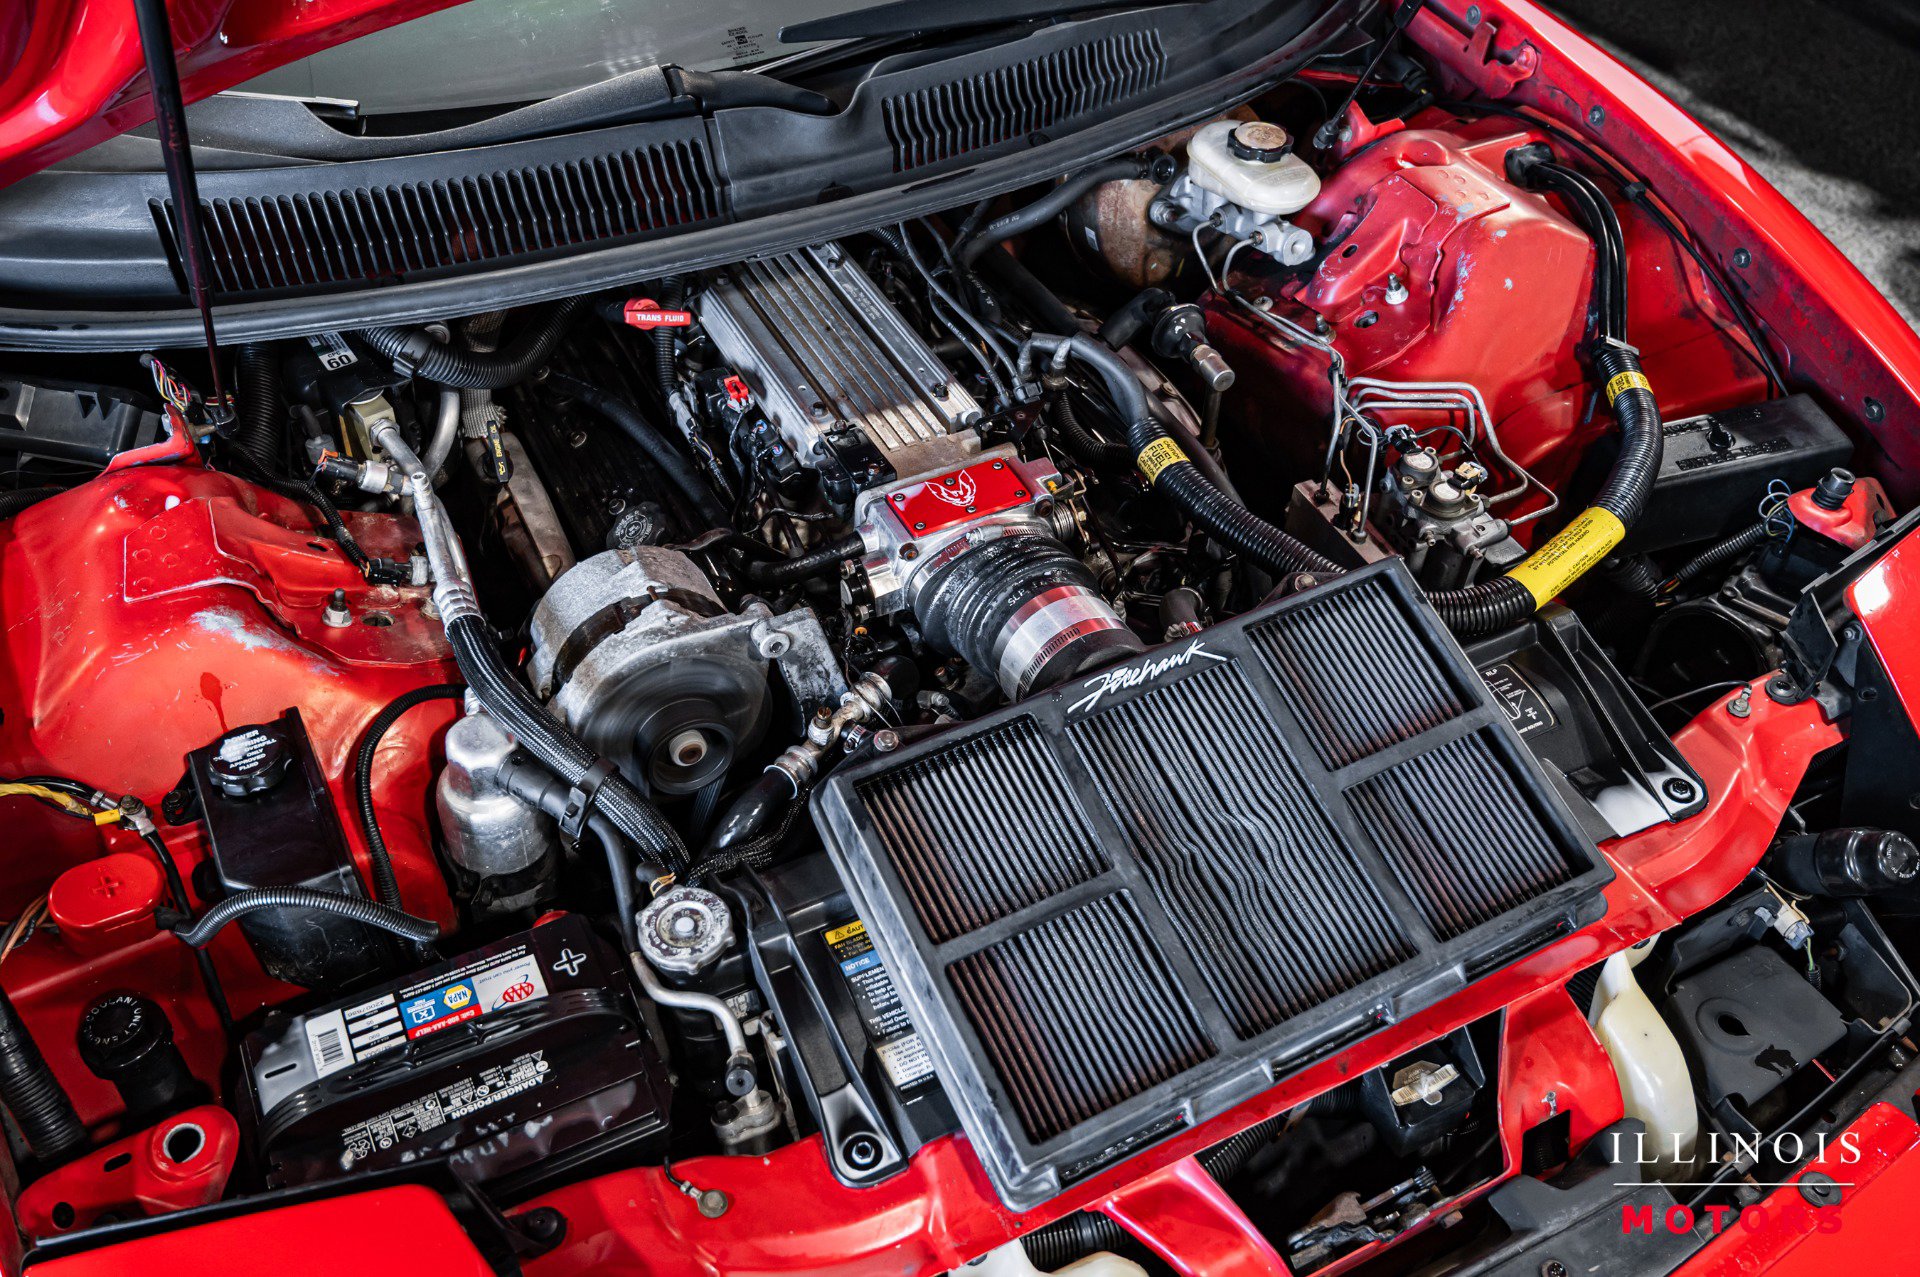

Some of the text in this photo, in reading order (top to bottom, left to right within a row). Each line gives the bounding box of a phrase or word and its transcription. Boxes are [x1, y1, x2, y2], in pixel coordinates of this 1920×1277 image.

[636, 313, 685, 322] TRANS FLUID
[327, 354, 352, 369] 60
[1148, 445, 1166, 466] FUEL
[1163, 440, 1181, 459] CAUTION
[1140, 456, 1156, 476] CAUTION
[1566, 541, 1575, 549] FIRE
[1007, 588, 1026, 606] SLP
[1067, 637, 1227, 714] Firehawk
[224, 730, 259, 745] POWER
[244, 739, 277, 753] OVERFILL
[246, 748, 263, 758] ONLY
[230, 753, 266, 769] APPROVED
[239, 761, 259, 771] FLUID
[513, 961, 530, 970] Power
[844, 956, 870, 971] NOTICE
[861, 976, 873, 985] This
[864, 977, 889, 991] inflatable
[446, 989, 468, 1004] NAPA
[502, 982, 535, 1002] AAA
[869, 991, 890, 1003] Manual
[874, 985, 886, 995] help
[868, 1006, 906, 1024] THIS VEHICLE
[879, 1018, 893, 1027] Read
[413, 1009, 475, 1037] Call: 800-AAA-HELP
[881, 1023, 900, 1034] Failure
[449, 1077, 537, 1119] DANGER/POISON
